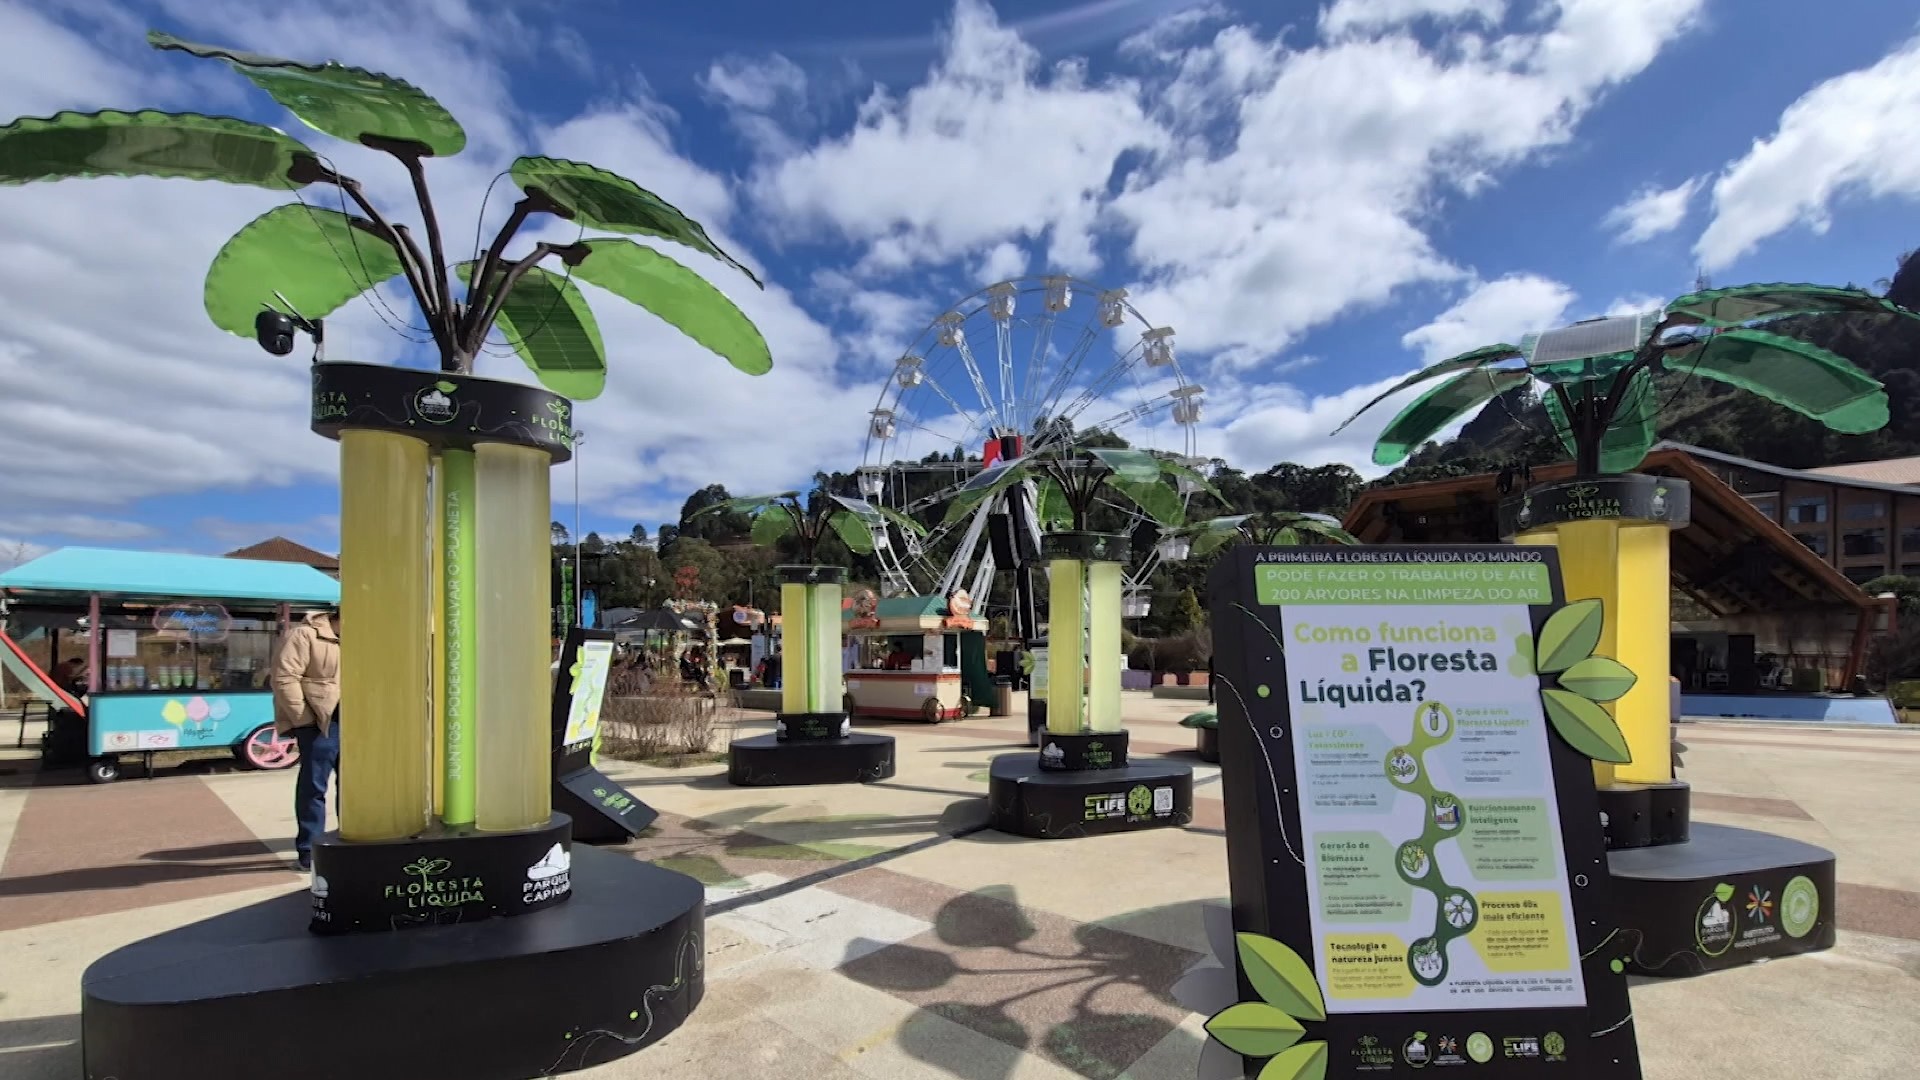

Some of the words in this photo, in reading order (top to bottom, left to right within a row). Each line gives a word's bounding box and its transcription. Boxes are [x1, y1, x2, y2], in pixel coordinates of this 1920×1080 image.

[1555, 498, 1620, 511] FLORESTA
[447, 489, 460, 557] PLANETA
[1255, 552, 1266, 562] A
[1268, 552, 1333, 562] PRIMEIRA
[1336, 552, 1403, 562] FLORESTA
[1406, 550, 1461, 563] LÍQUIDA
[1465, 552, 1485, 562] DO
[1489, 552, 1542, 562] MUNDO
[447, 564, 460, 576] O
[1267, 569, 1312, 581] PODE
[1318, 569, 1368, 581] FAZER
[1373, 569, 1385, 581] O
[1392, 569, 1477, 581] TRABALHO
[1482, 569, 1504, 581] DE
[1272, 588, 1300, 600] 200
[1386, 588, 1409, 600] NA
[1413, 588, 1484, 600] LIMPEZA
[1488, 588, 1512, 599] DO
[1517, 588, 1539, 599] AR
[447, 580, 461, 637] SALVAR
[1294, 623, 1371, 643] Como
[1378, 621, 1497, 643] funciona
[1341, 653, 1359, 673] a
[1368, 646, 1498, 673] Floresta
[448, 641, 461, 717] PODEMOS
[1300, 676, 1426, 708] Líquida?
[448, 721, 461, 780] JUNTOS
[1096, 799, 1125, 813] LIFE
[385, 877, 484, 898] FLORESTA
[1481, 900, 1520, 909] Processo
[1330, 942, 1379, 953] Tecnologia
[1332, 955, 1373, 963] natureza
[1374, 954, 1403, 964] juntas
